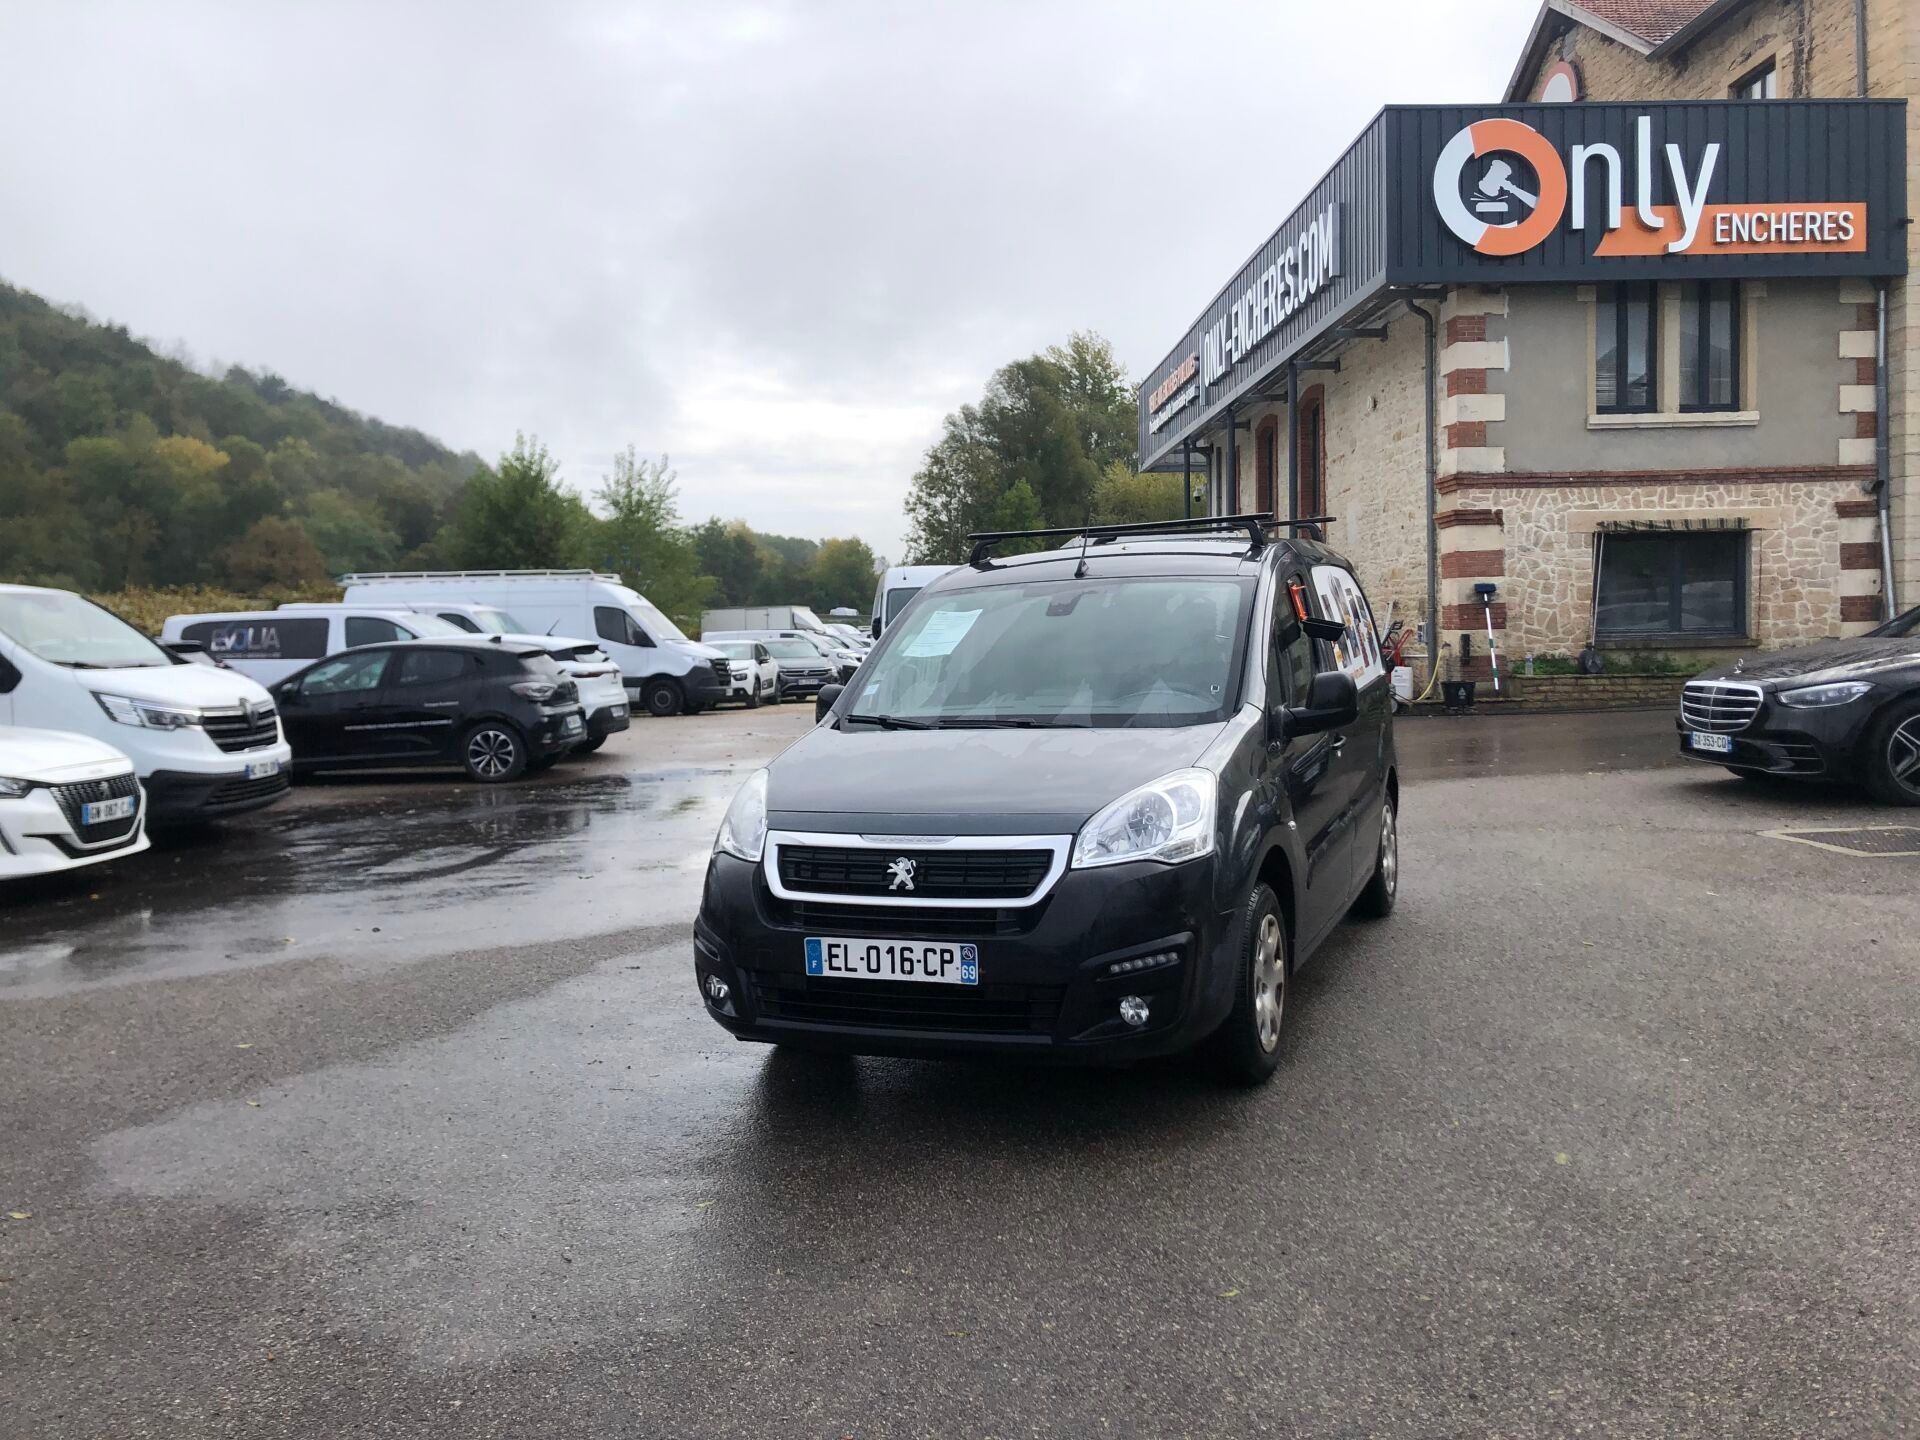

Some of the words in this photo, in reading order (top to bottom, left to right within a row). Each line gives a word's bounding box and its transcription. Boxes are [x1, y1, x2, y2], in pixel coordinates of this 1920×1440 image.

[1433, 115, 1720, 256] Only
[1714, 211, 1855, 243] ENCHERES
[1203, 201, 1339, 388] ONLY-ENCHERES.COM
[812, 960, 818, 969] F
[827, 943, 955, 977] EL-016-CP
[961, 965, 977, 980] 69
